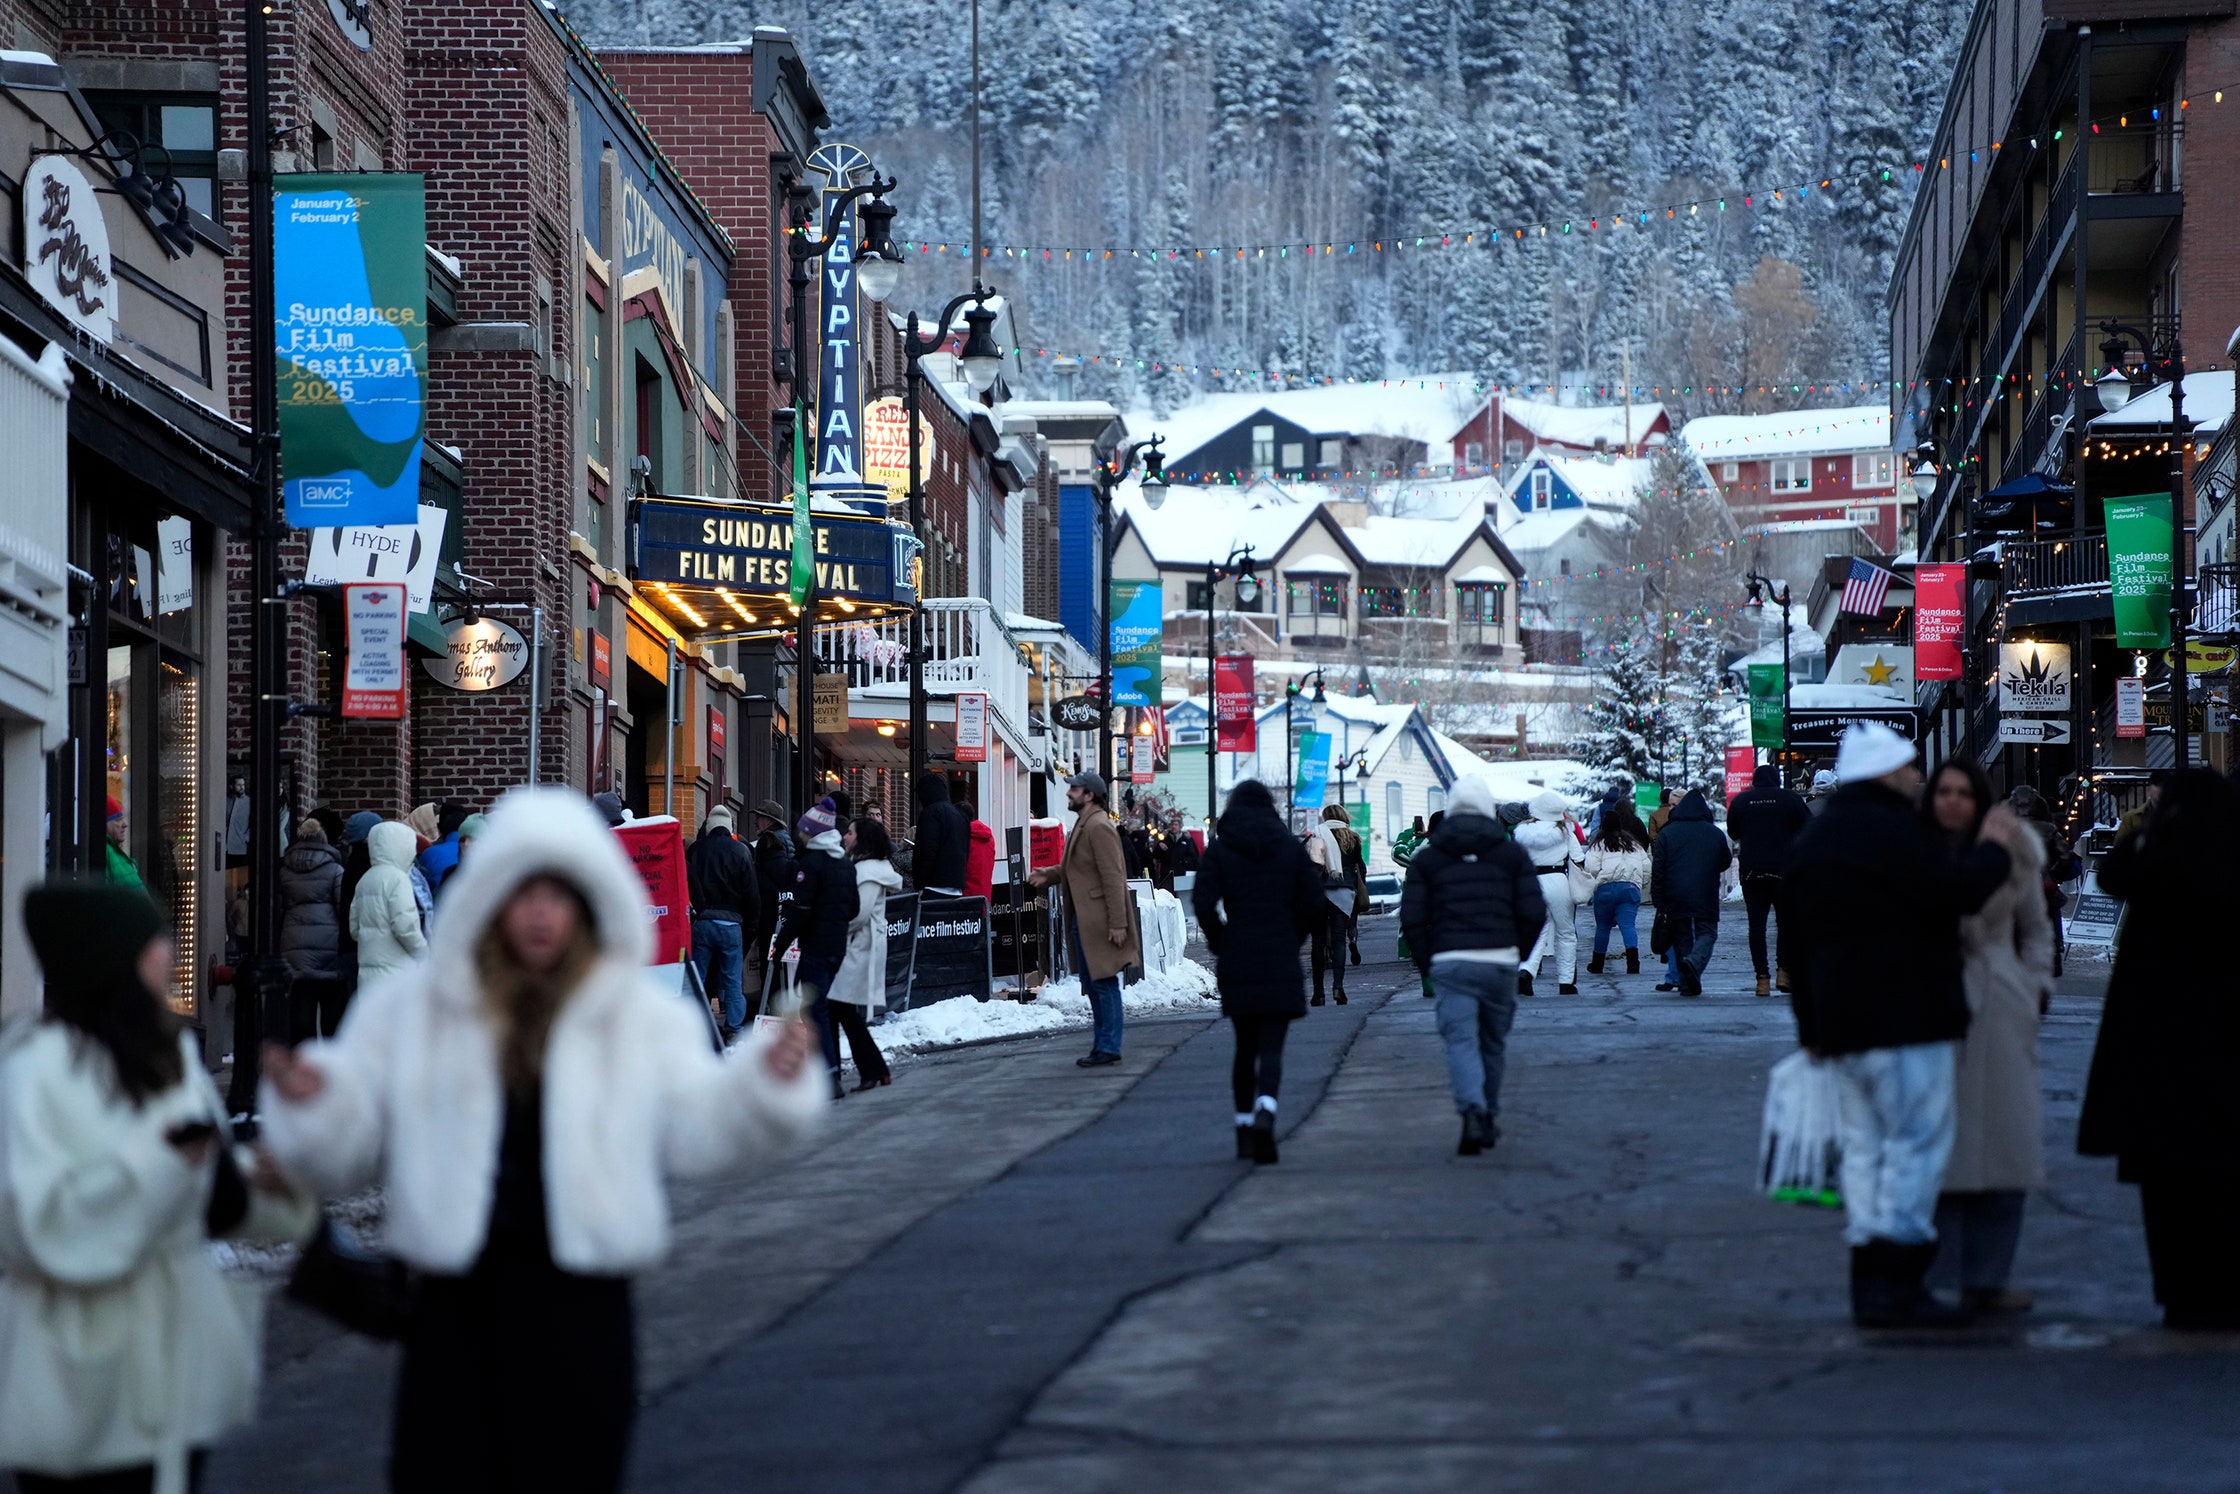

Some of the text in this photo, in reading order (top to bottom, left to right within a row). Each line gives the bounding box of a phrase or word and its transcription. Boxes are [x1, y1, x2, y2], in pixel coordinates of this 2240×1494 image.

[291, 198, 343, 210] January
[291, 212, 360, 224] February 2
[289, 303, 415, 322] Sundance
[291, 328, 354, 348] Film
[291, 353, 414, 374] Festival
[292, 381, 355, 401] 2025
[865, 448, 923, 470] PIZZ
[879, 469, 900, 478] PASTA
[352, 531, 401, 554] HYDE
[2115, 552, 2170, 562] Sundance
[679, 551, 860, 591] FILM FESVAL
[2116, 563, 2145, 573] Film
[2117, 574, 2168, 584] Festival
[2119, 585, 2147, 595] 2025
[410, 593, 424, 604] ur
[1115, 626, 1159, 634] Sundance
[448, 631, 522, 661] mas Anthony
[1115, 644, 1158, 652] Festival
[1116, 654, 1137, 662] 2025
[454, 656, 497, 687] Gallery
[2008, 679, 2066, 695] Tekila
[1792, 720, 1834, 731] Treasure
[1887, 720, 1905, 731] Inn
[2001, 727, 2013, 735] Up
[936, 920, 952, 937] film
[952, 918, 982, 936] festival
